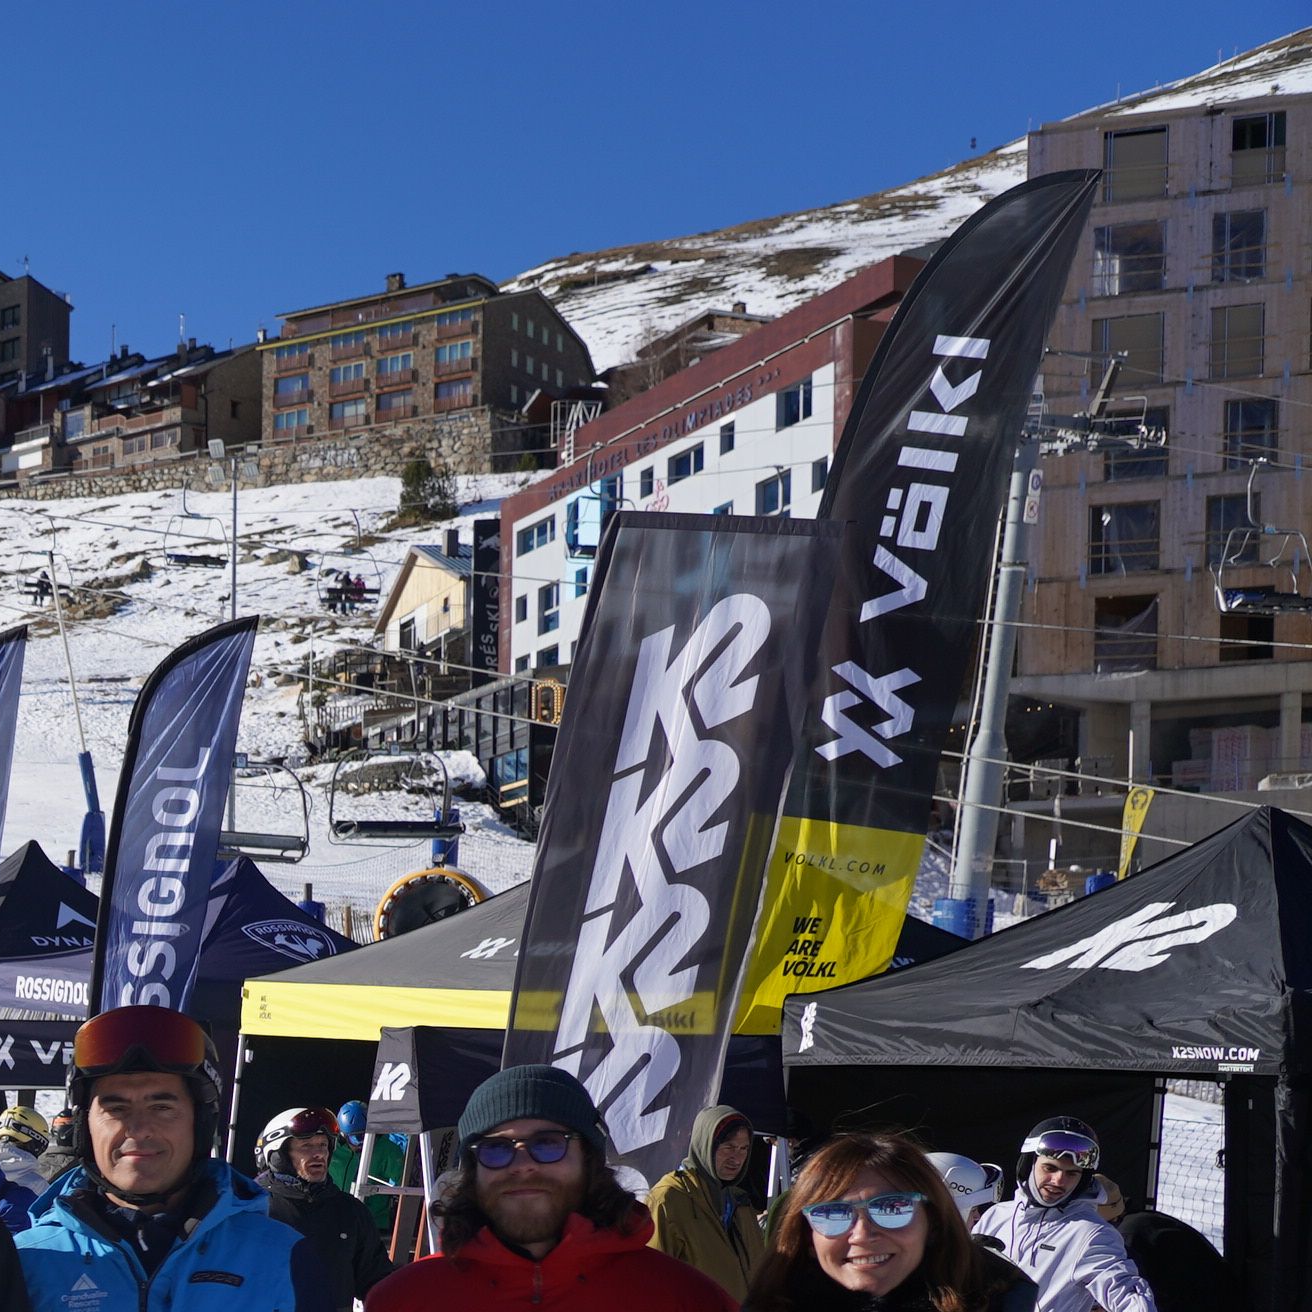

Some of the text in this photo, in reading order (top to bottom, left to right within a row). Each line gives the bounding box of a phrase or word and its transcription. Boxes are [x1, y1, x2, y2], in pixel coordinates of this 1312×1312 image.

[662, 384, 753, 441] OLIMPIADES
[613, 593, 771, 773] K2
[584, 739, 740, 915] K2
[123, 746, 211, 1007] SSIGNOL
[785, 939, 824, 957] ARE
[793, 917, 822, 934] WE
[1019, 902, 1237, 971] K2
[553, 883, 710, 1054] K2
[371, 1063, 411, 1100] K2
[1172, 1046, 1260, 1061] K2SNOW.COM
